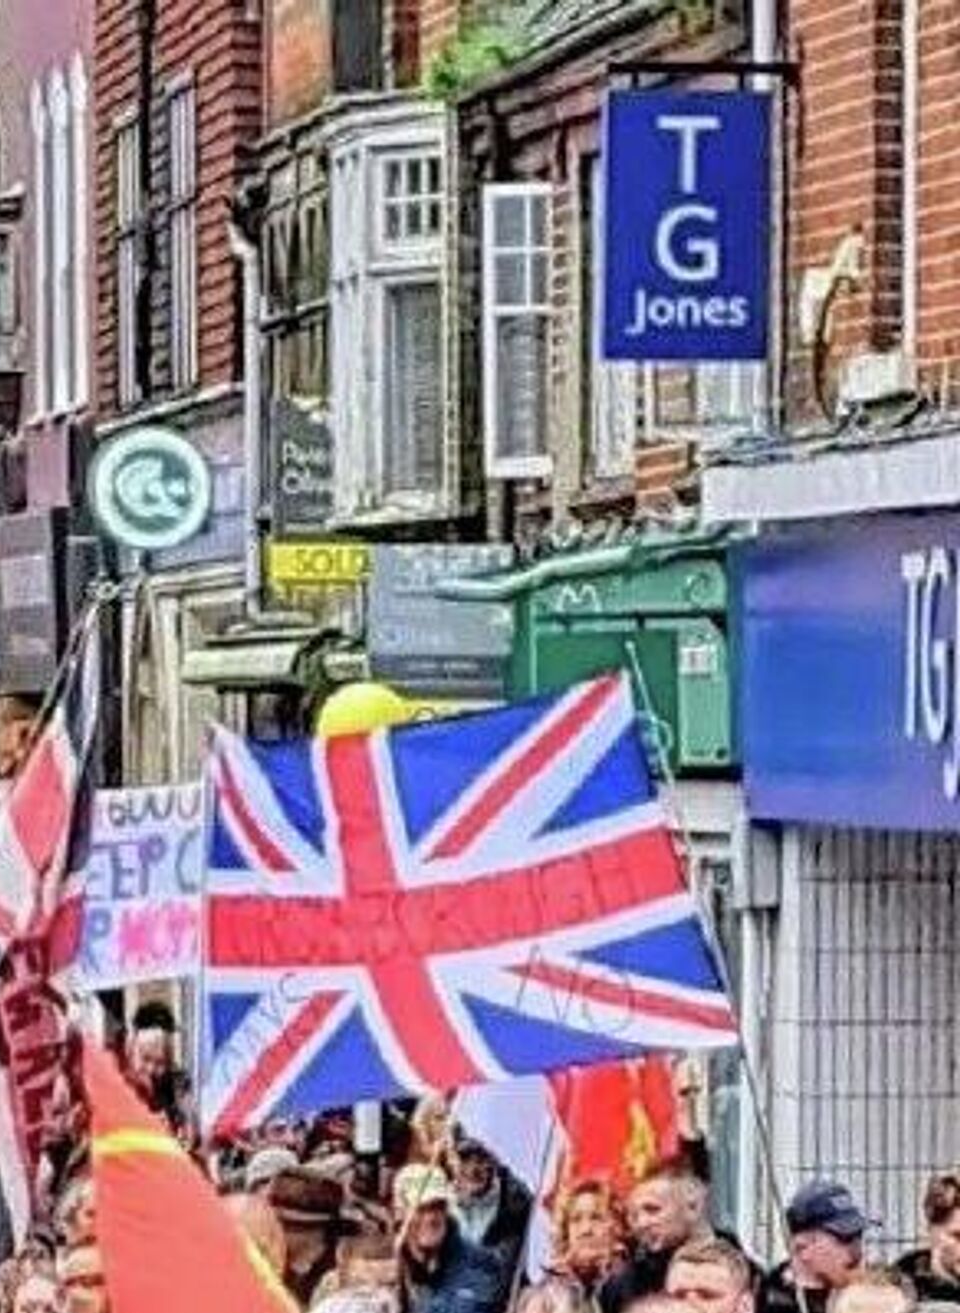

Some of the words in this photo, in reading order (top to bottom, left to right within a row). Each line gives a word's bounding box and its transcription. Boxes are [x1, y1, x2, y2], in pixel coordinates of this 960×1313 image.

[656, 115, 721, 194] T
[656, 204, 719, 281] G
[624, 288, 748, 334] Jones
[296, 548, 370, 574] SOLD
